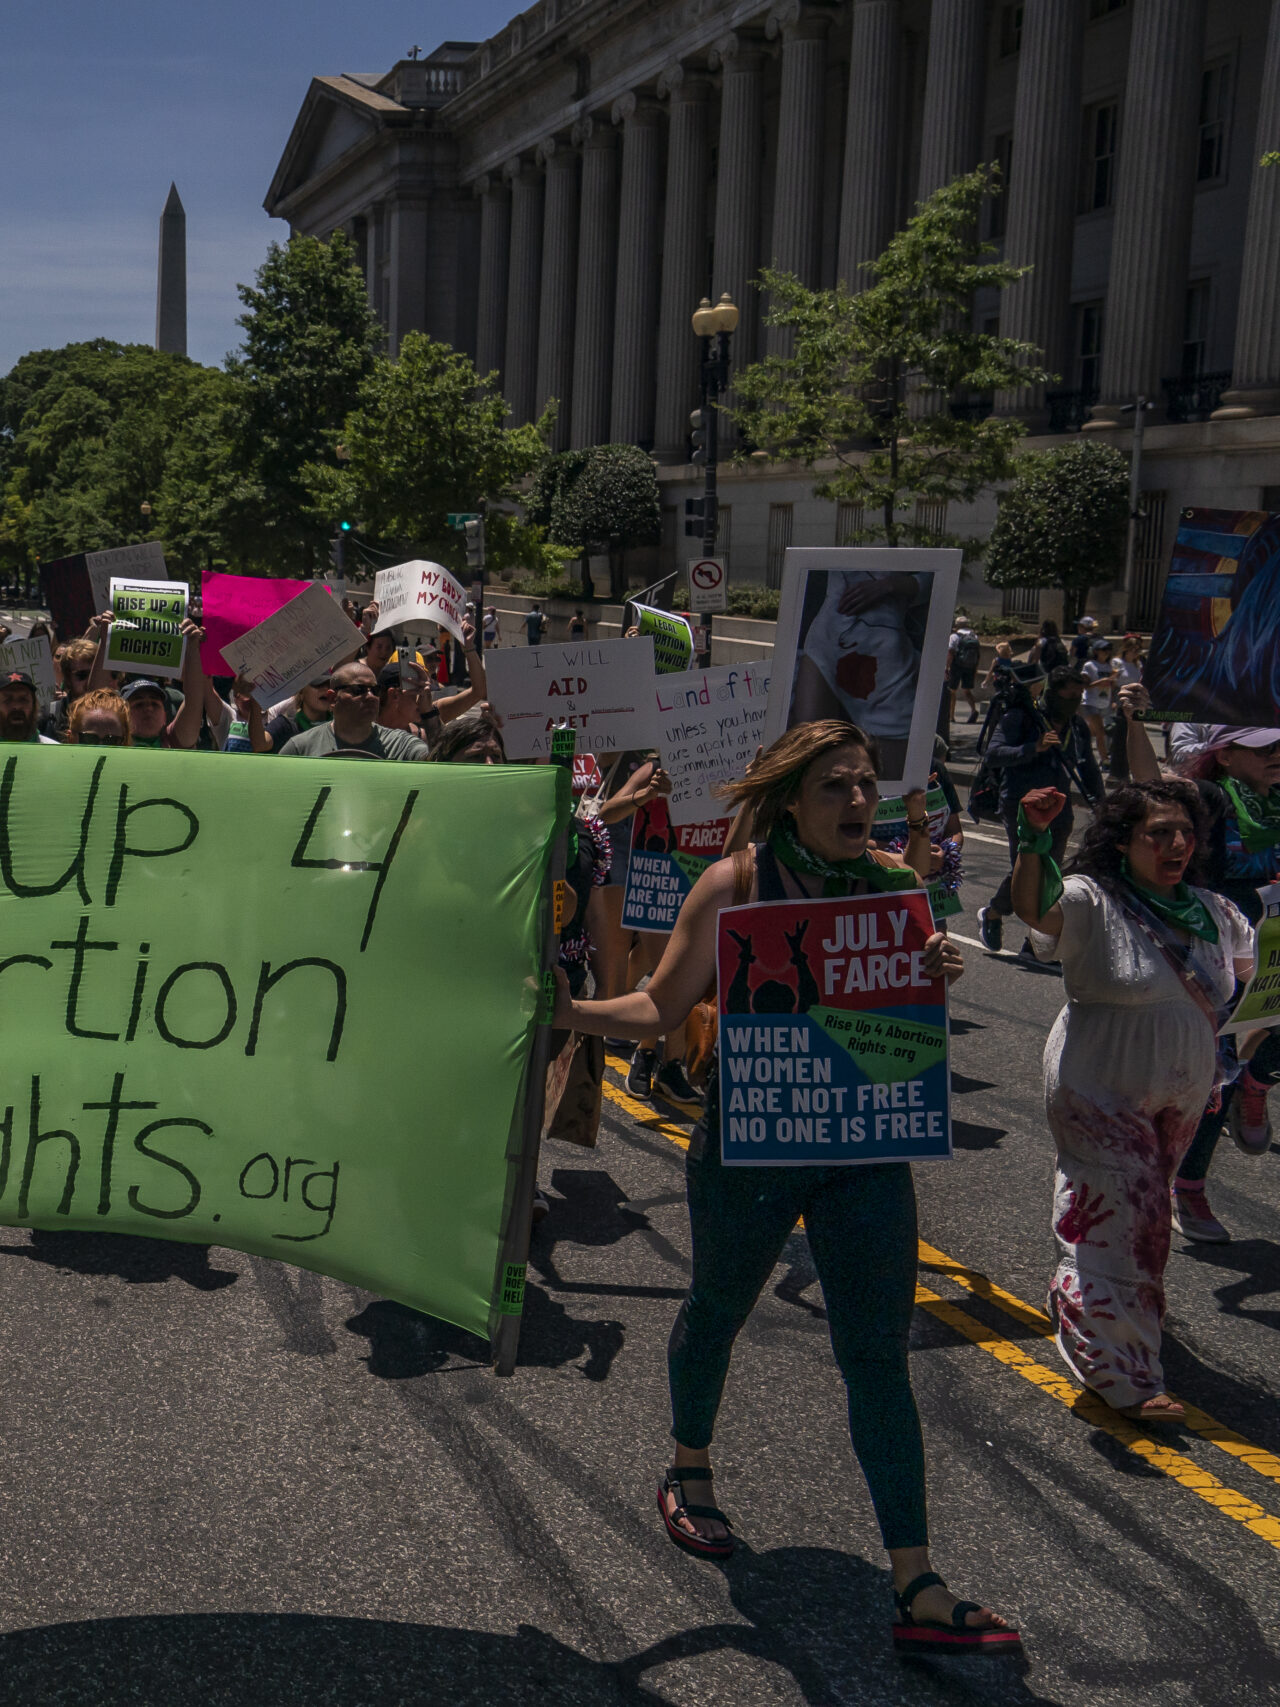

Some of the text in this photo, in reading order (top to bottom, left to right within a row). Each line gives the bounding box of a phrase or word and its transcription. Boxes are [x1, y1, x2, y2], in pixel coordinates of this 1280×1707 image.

[421, 571, 440, 586] MY
[117, 597, 181, 615] RISE UP 4
[417, 592, 439, 606] MY
[653, 617, 678, 635] LEGAL
[20, 640, 43, 663] NOT
[120, 638, 172, 657] RIGHTS!
[533, 650, 610, 669] I WILL
[547, 677, 588, 697] AID
[656, 676, 710, 712] Land
[717, 671, 738, 701] of
[566, 700, 576, 711] &
[666, 722, 707, 743] unless
[717, 717, 739, 737] you
[668, 748, 689, 761] are
[738, 731, 748, 745] of
[670, 753, 734, 776] community,
[671, 790, 691, 803] are
[680, 827, 726, 850] FARCE
[291, 786, 419, 952] 4
[633, 856, 671, 876] WHEN
[630, 872, 680, 892] WOMEN
[628, 888, 686, 908] ARE NOT
[626, 903, 675, 923] NO ONE
[822, 908, 909, 953] JULY
[824, 951, 933, 996] FARCE
[727, 1027, 809, 1054] WHEN
[825, 1013, 944, 1049] Rise Up 4 Abortion
[848, 1037, 917, 1062] Rights .org
[728, 1057, 832, 1084] WOMEN
[728, 1080, 925, 1113] ARE NOT FREE
[729, 1111, 944, 1144] NO ONE IS FREE
